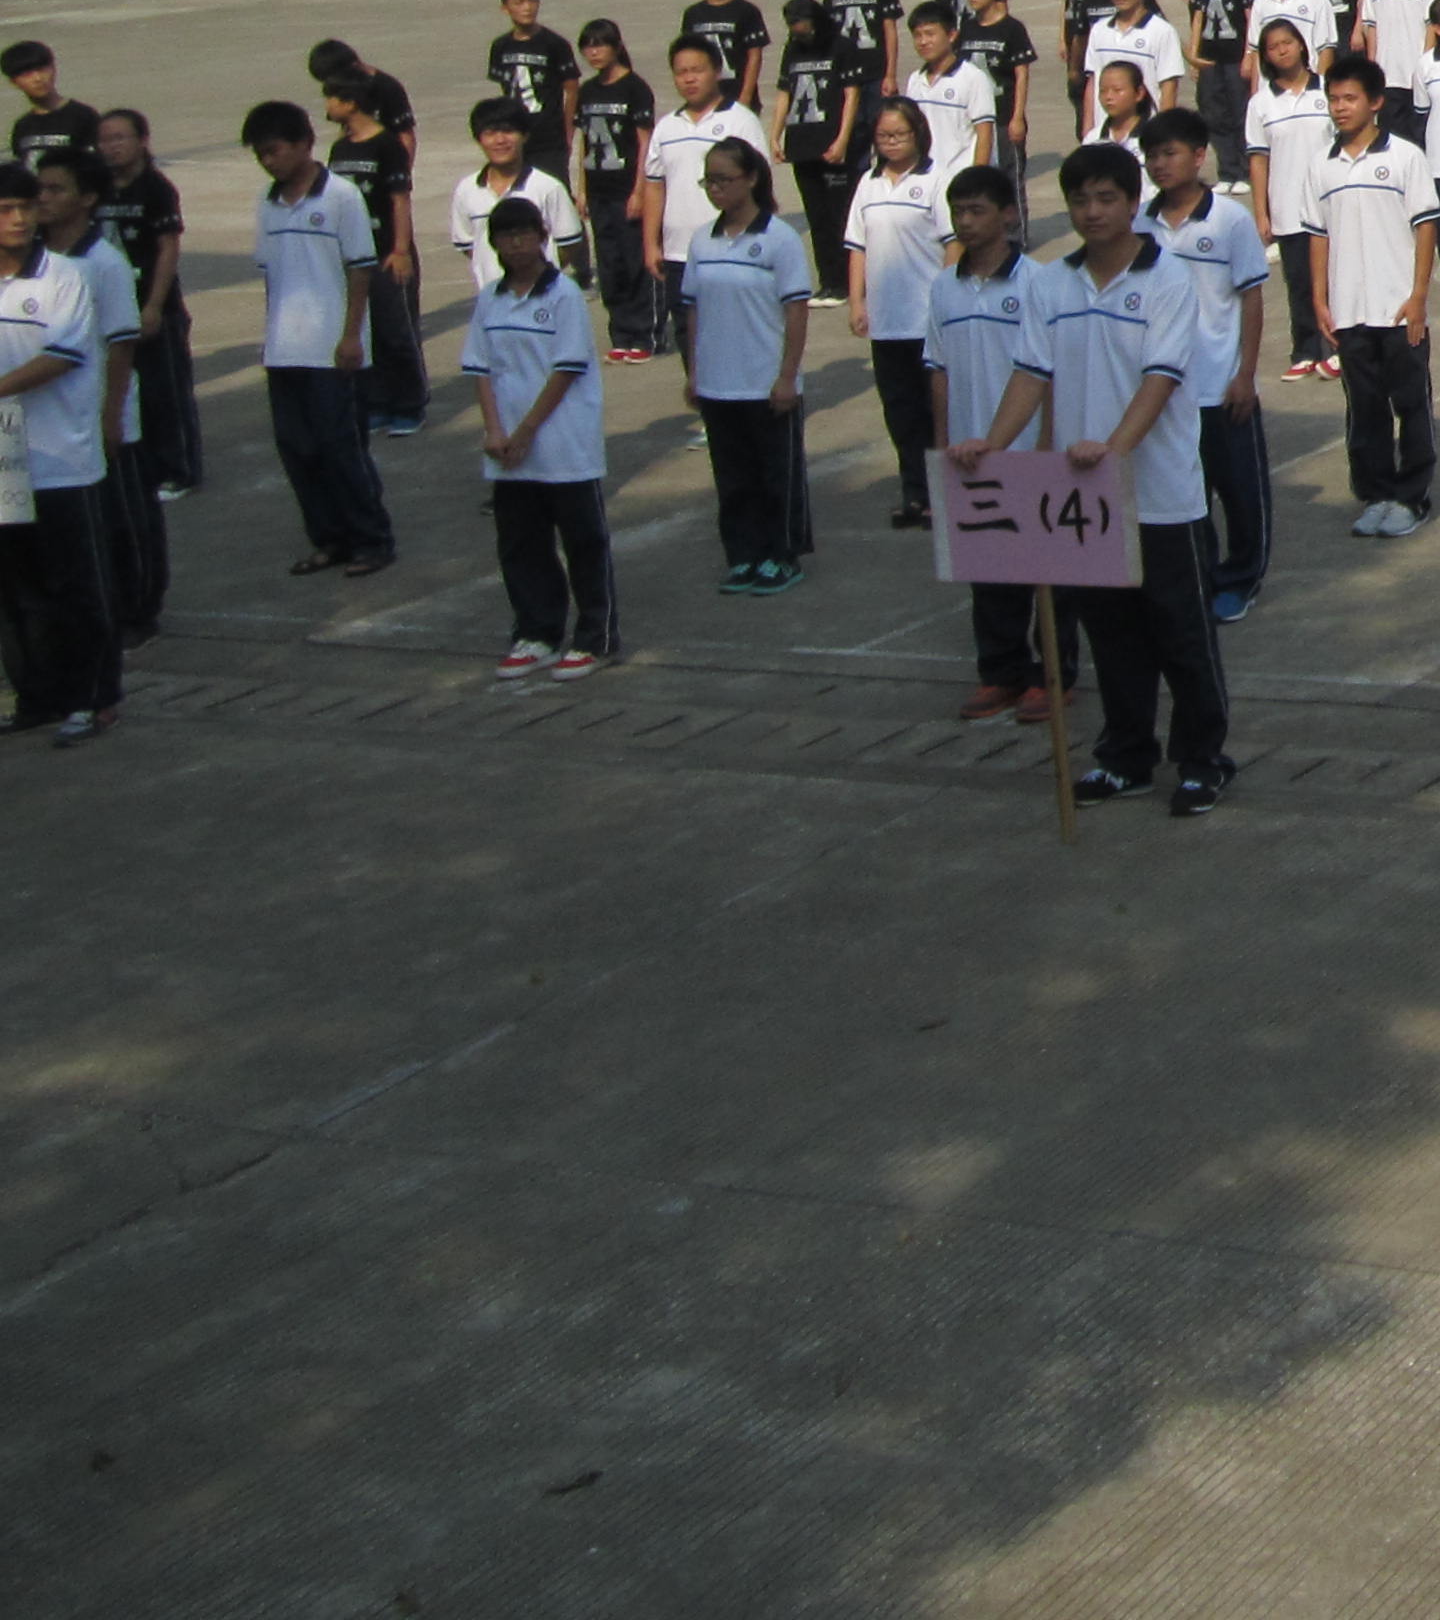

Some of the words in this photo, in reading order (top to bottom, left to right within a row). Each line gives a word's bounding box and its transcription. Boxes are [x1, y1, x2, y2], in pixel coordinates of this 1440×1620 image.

[840, 6, 876, 49] A
[786, 74, 825, 124] A
[584, 116, 626, 171] A
